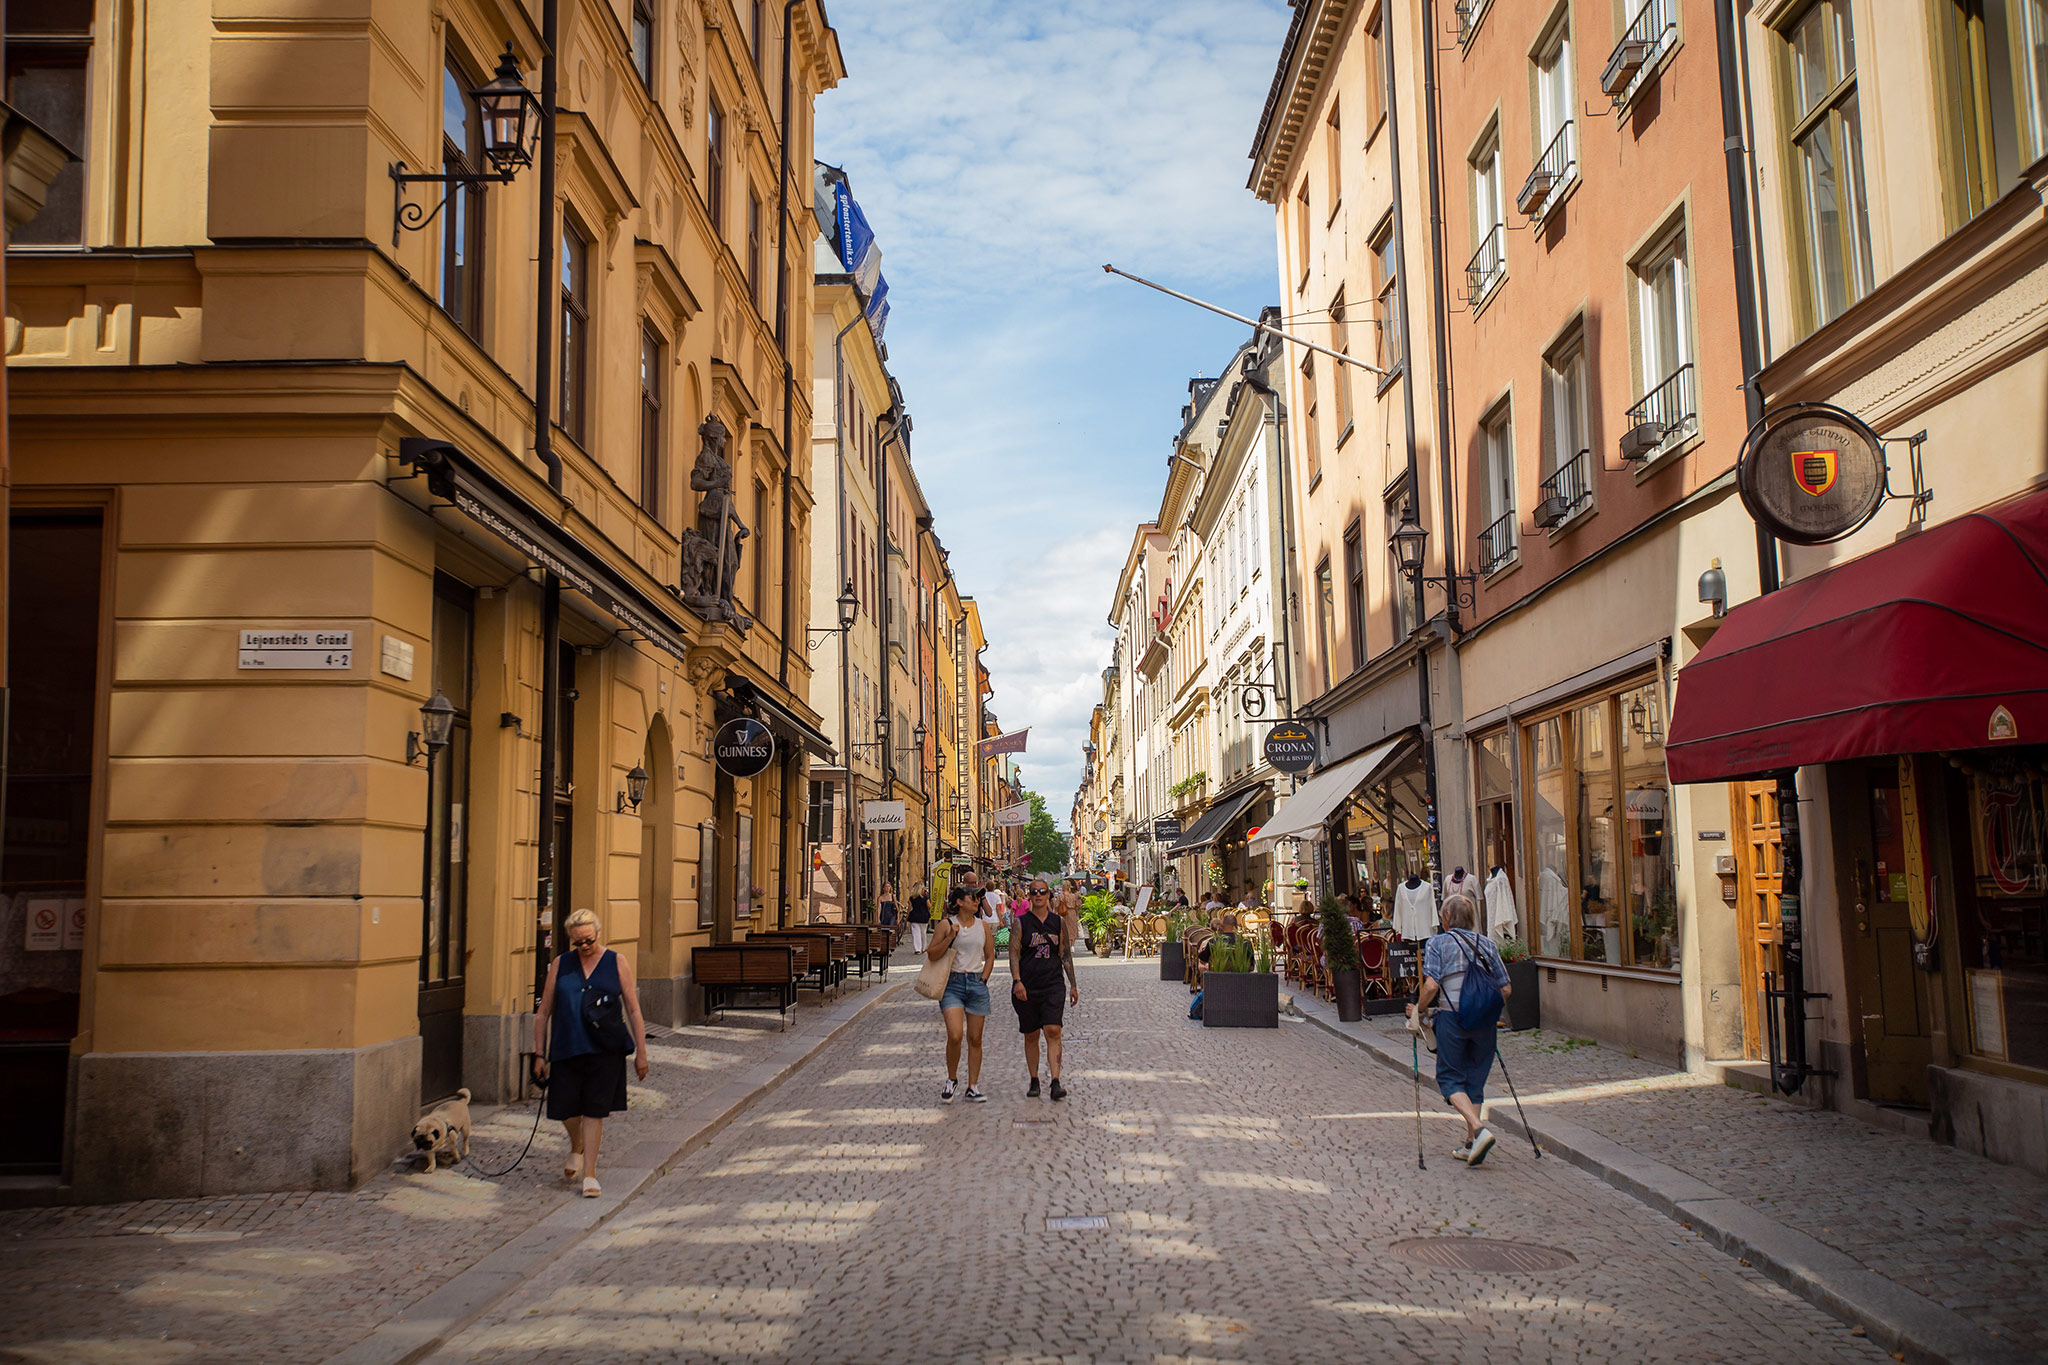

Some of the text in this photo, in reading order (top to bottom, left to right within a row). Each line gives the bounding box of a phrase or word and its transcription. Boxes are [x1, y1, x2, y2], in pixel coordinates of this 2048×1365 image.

[839, 194, 854, 266] gpfonsterteknik.se
[246, 633, 348, 648] Lejonstedts Gränd
[718, 745, 768, 758] GUINNESS
[1266, 742, 1314, 753] CRONAN
[1034, 944, 1050, 959] 24
